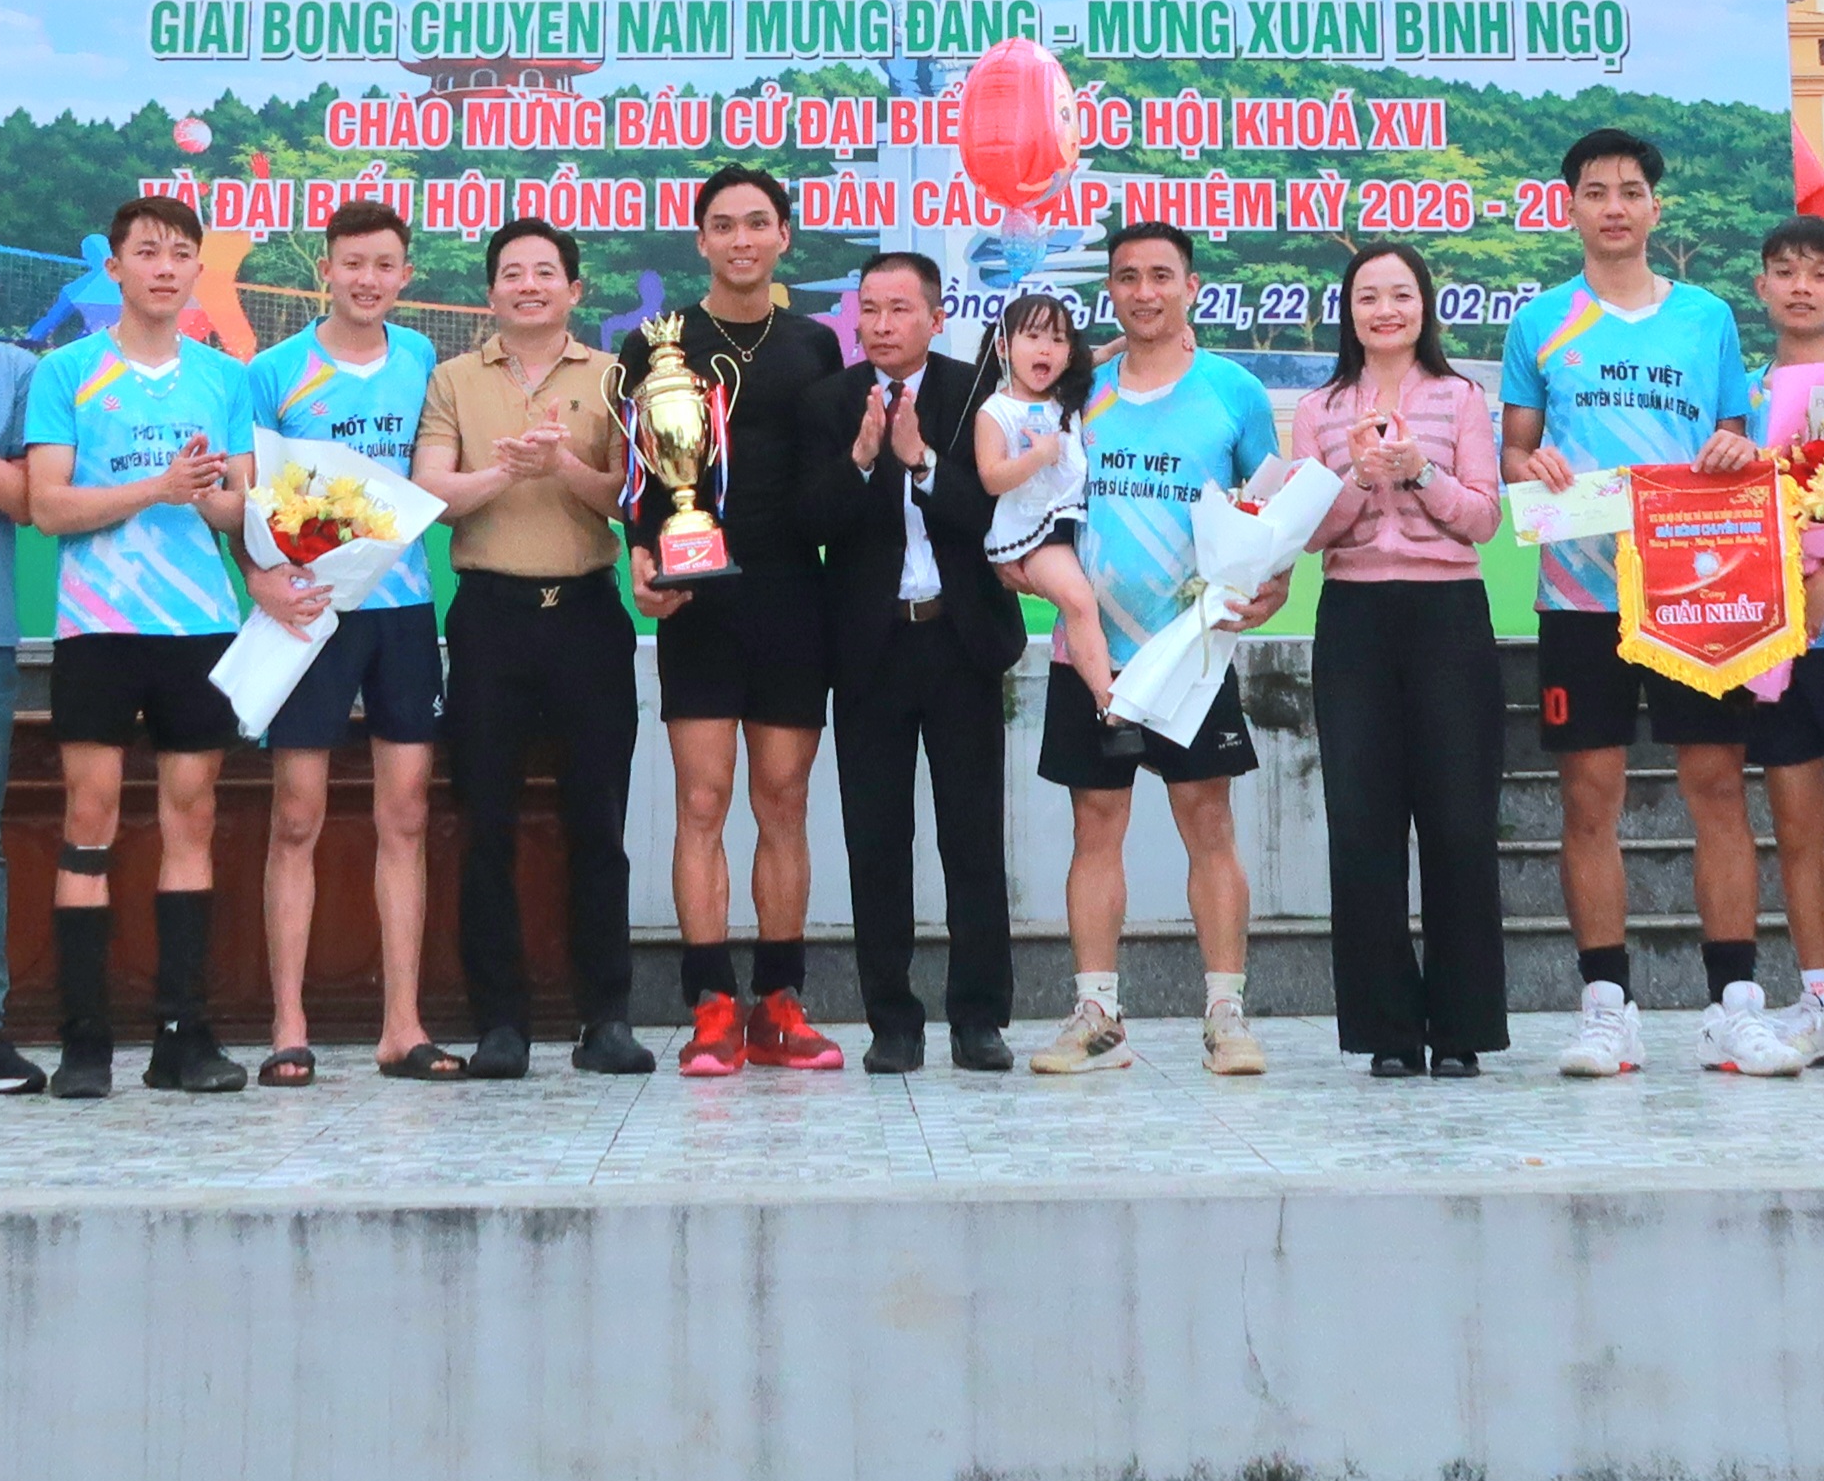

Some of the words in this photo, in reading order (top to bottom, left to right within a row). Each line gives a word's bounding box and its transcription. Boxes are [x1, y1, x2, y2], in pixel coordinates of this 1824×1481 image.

[619, 0, 729, 55] NAM
[1053, 22, 1073, 39] -
[1528, 0, 1625, 67] NGỌ
[329, 91, 454, 147] CHÀO
[465, 86, 603, 147] MỪNG
[619, 85, 707, 147] BẦU
[725, 84, 787, 147] CỬ
[799, 99, 873, 155] ĐẠI
[892, 82, 961, 146] BIỂ
[1146, 89, 1219, 158] HỘI
[1238, 89, 1362, 147] KHOÁ
[1374, 99, 1443, 147] XVI
[214, 179, 289, 238] ĐẠI
[427, 170, 504, 240] HỘI
[517, 164, 641, 228] ĐỒNG
[803, 171, 895, 227] DÂN
[1125, 175, 1273, 237] NHIỆM
[1290, 170, 1349, 228] KỲ
[1362, 180, 1472, 229] 2026
[1485, 202, 1503, 214] -
[941, 277, 1005, 326] ồng
[1199, 287, 1252, 325] 21,
[1263, 287, 1305, 319] 22
[1439, 287, 1480, 320] 02
[1600, 359, 1639, 381] MỐT
[1647, 365, 1683, 388] VIỆT
[331, 414, 367, 439] MỐT
[1101, 447, 1136, 469] MỐT
[1144, 452, 1181, 476] VIỆT
[1706, 594, 1765, 623] NHẤT
